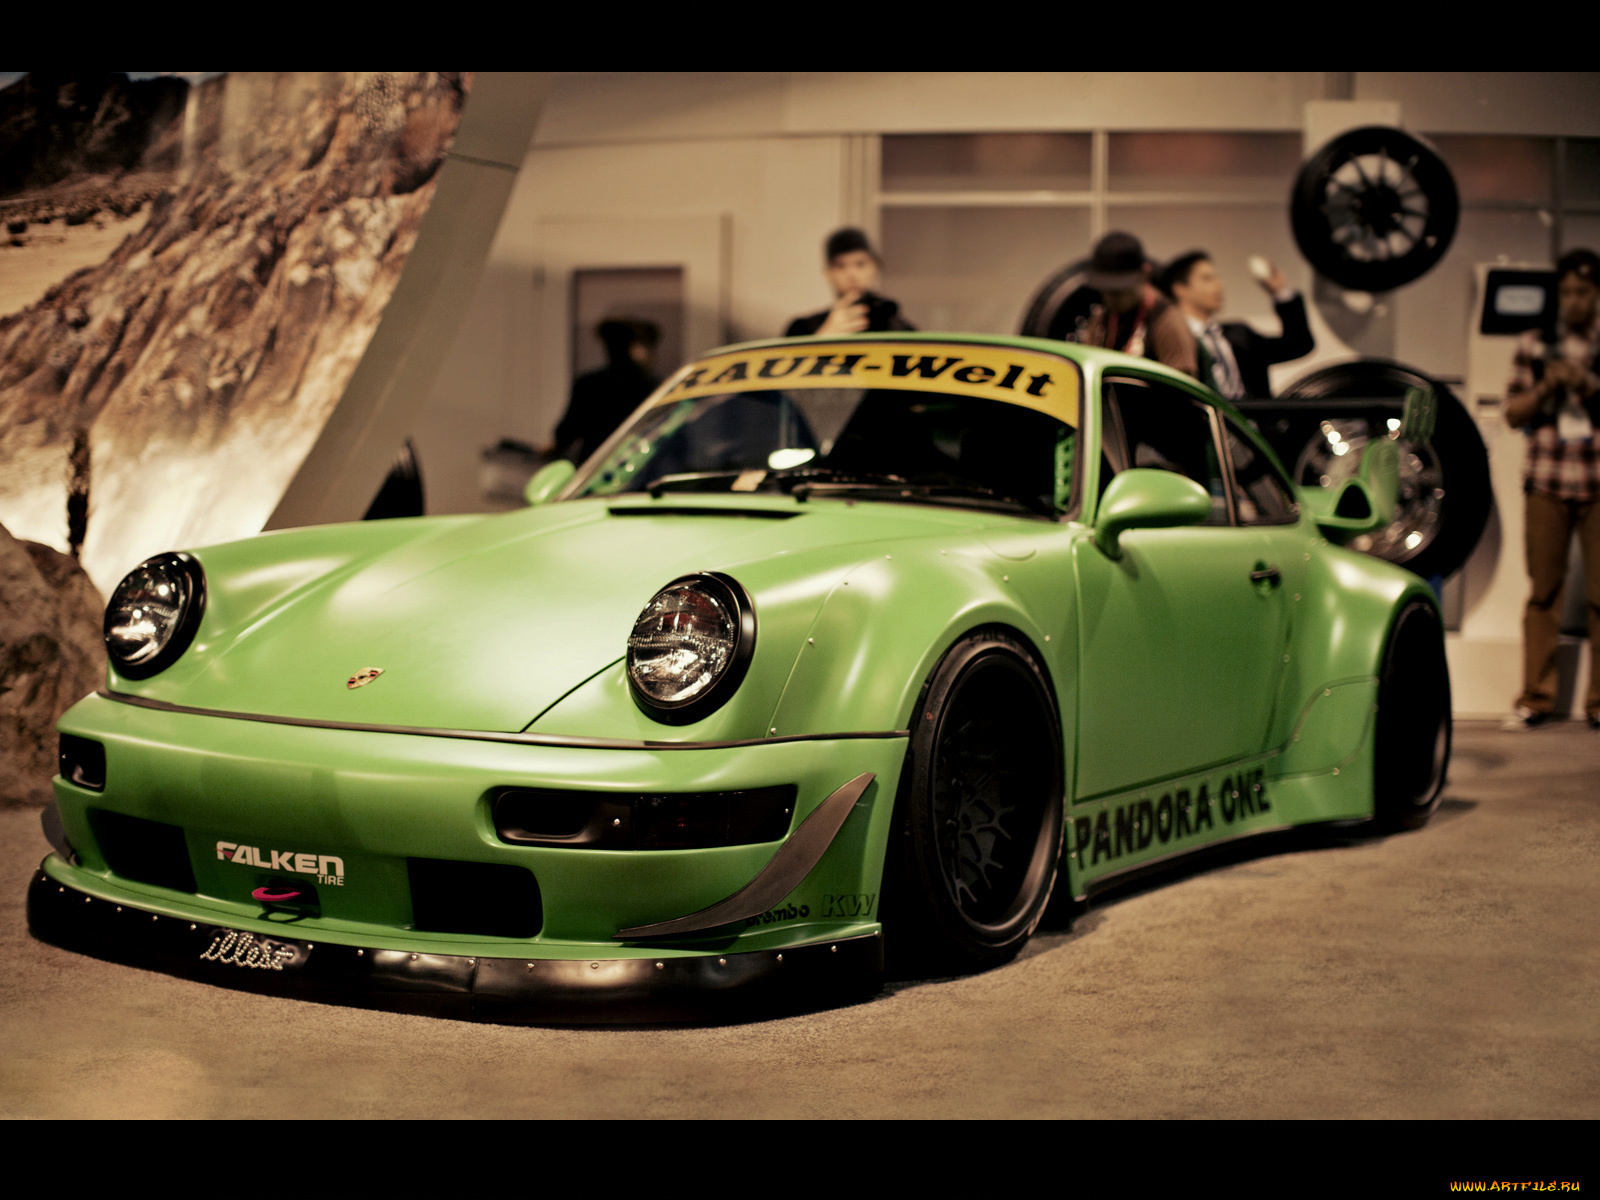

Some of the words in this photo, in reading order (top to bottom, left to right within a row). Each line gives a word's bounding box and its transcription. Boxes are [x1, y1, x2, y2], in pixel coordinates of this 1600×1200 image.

[1074, 782, 1213, 870] PANDORA
[1220, 769, 1271, 825] ONE
[215, 840, 345, 877] FALKEN
[317, 874, 345, 886] TIRE
[822, 893, 876, 917] KW
